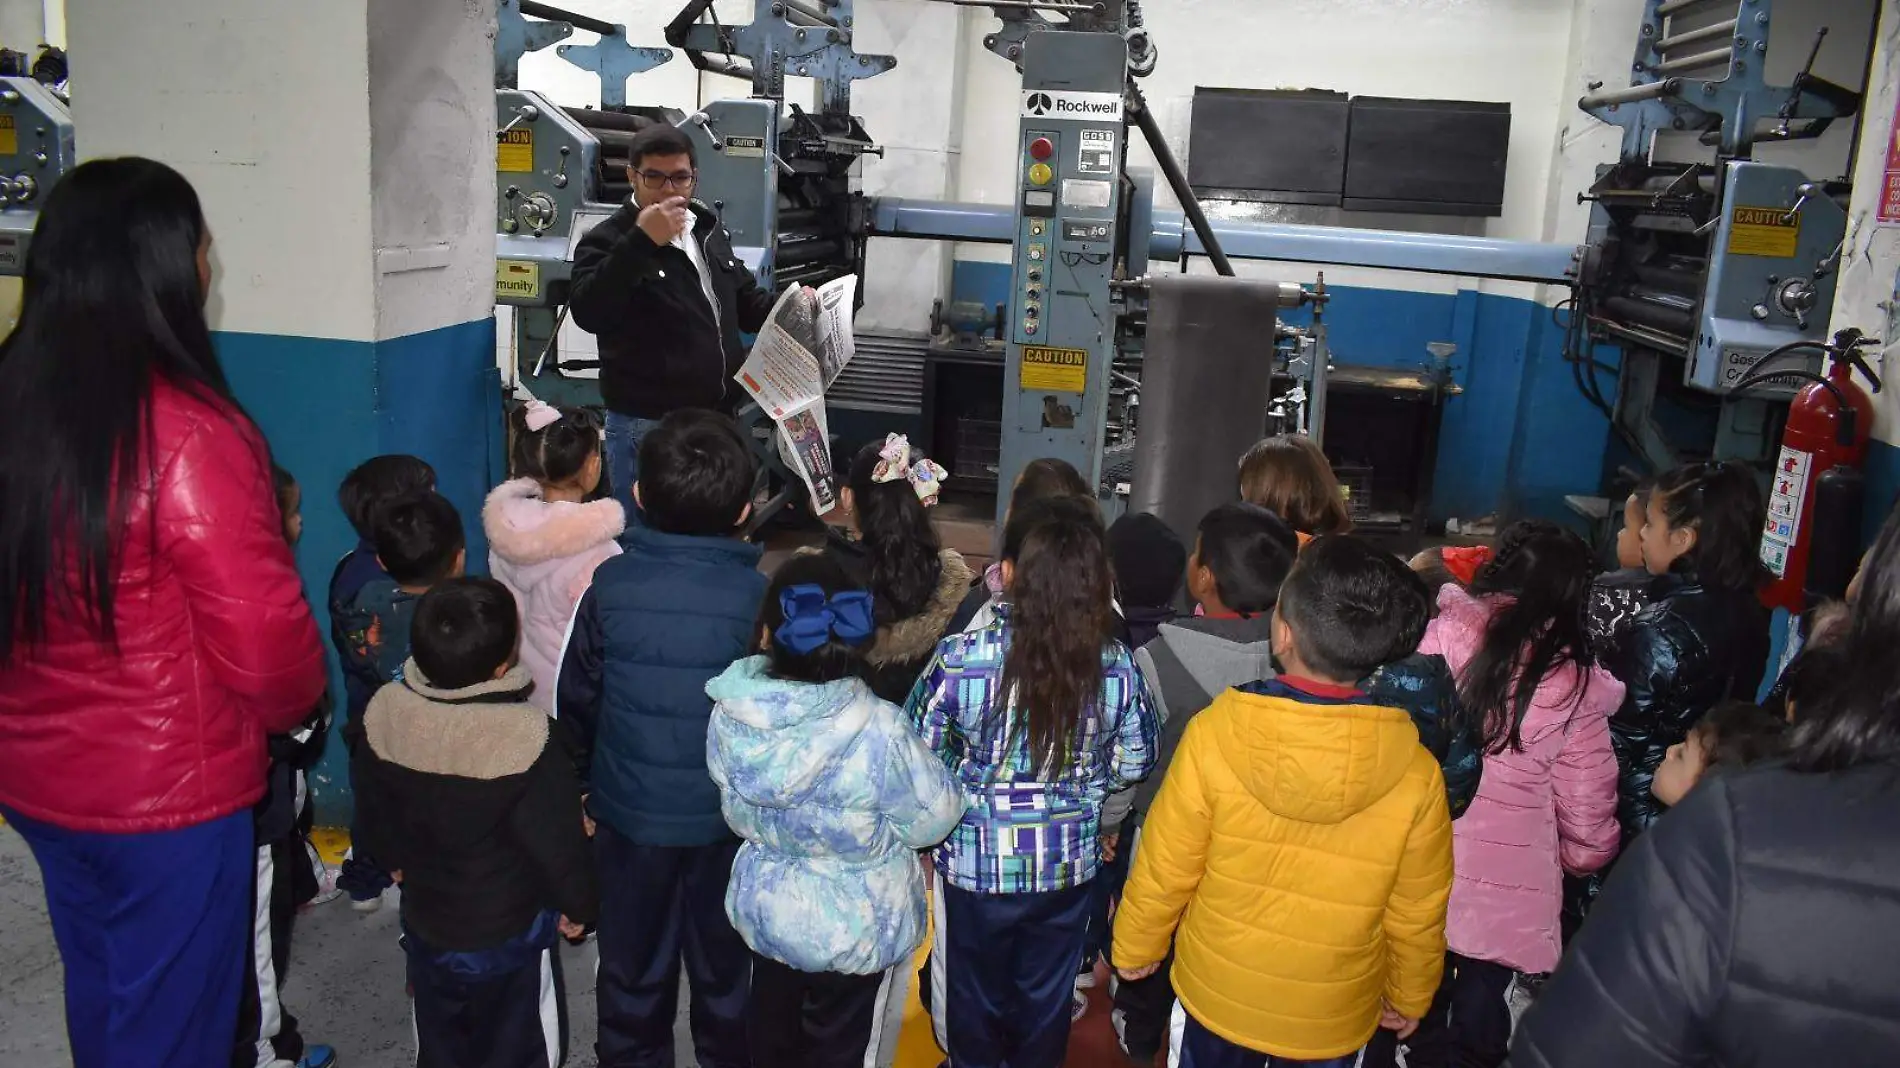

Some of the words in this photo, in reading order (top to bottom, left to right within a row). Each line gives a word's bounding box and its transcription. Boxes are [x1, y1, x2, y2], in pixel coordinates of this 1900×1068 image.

[1057, 99, 1117, 114] Rockwell
[1026, 349, 1083, 364] CAUTION
[1729, 353, 1762, 366] Gos
